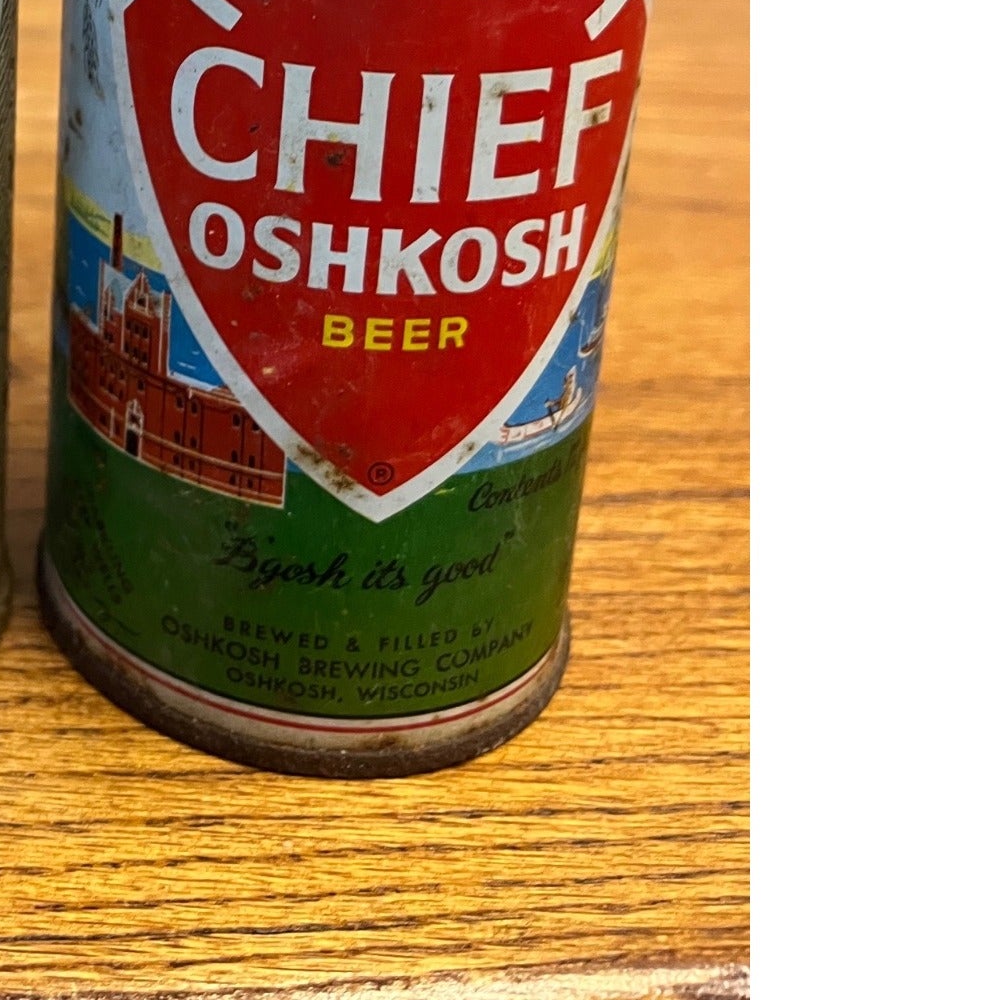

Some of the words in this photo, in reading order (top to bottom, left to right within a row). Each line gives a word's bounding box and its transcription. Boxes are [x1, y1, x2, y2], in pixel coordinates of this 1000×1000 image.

[170, 46, 625, 204] CHIEF
[188, 201, 587, 297] OSHKOSH
[321, 313, 470, 352] BEER
[468, 460, 563, 513] Contents
[160, 614, 281, 671] OSHKOSH
[297, 656, 421, 681] BREWING
[435, 620, 534, 673] COMPANY
[223, 616, 330, 652] BREWED
[347, 637, 361, 653] &
[379, 628, 459, 652] FILLED
[471, 616, 496, 639] BY
[226, 666, 344, 704] OSHKOSH,
[357, 669, 480, 703] WISCONSIN
